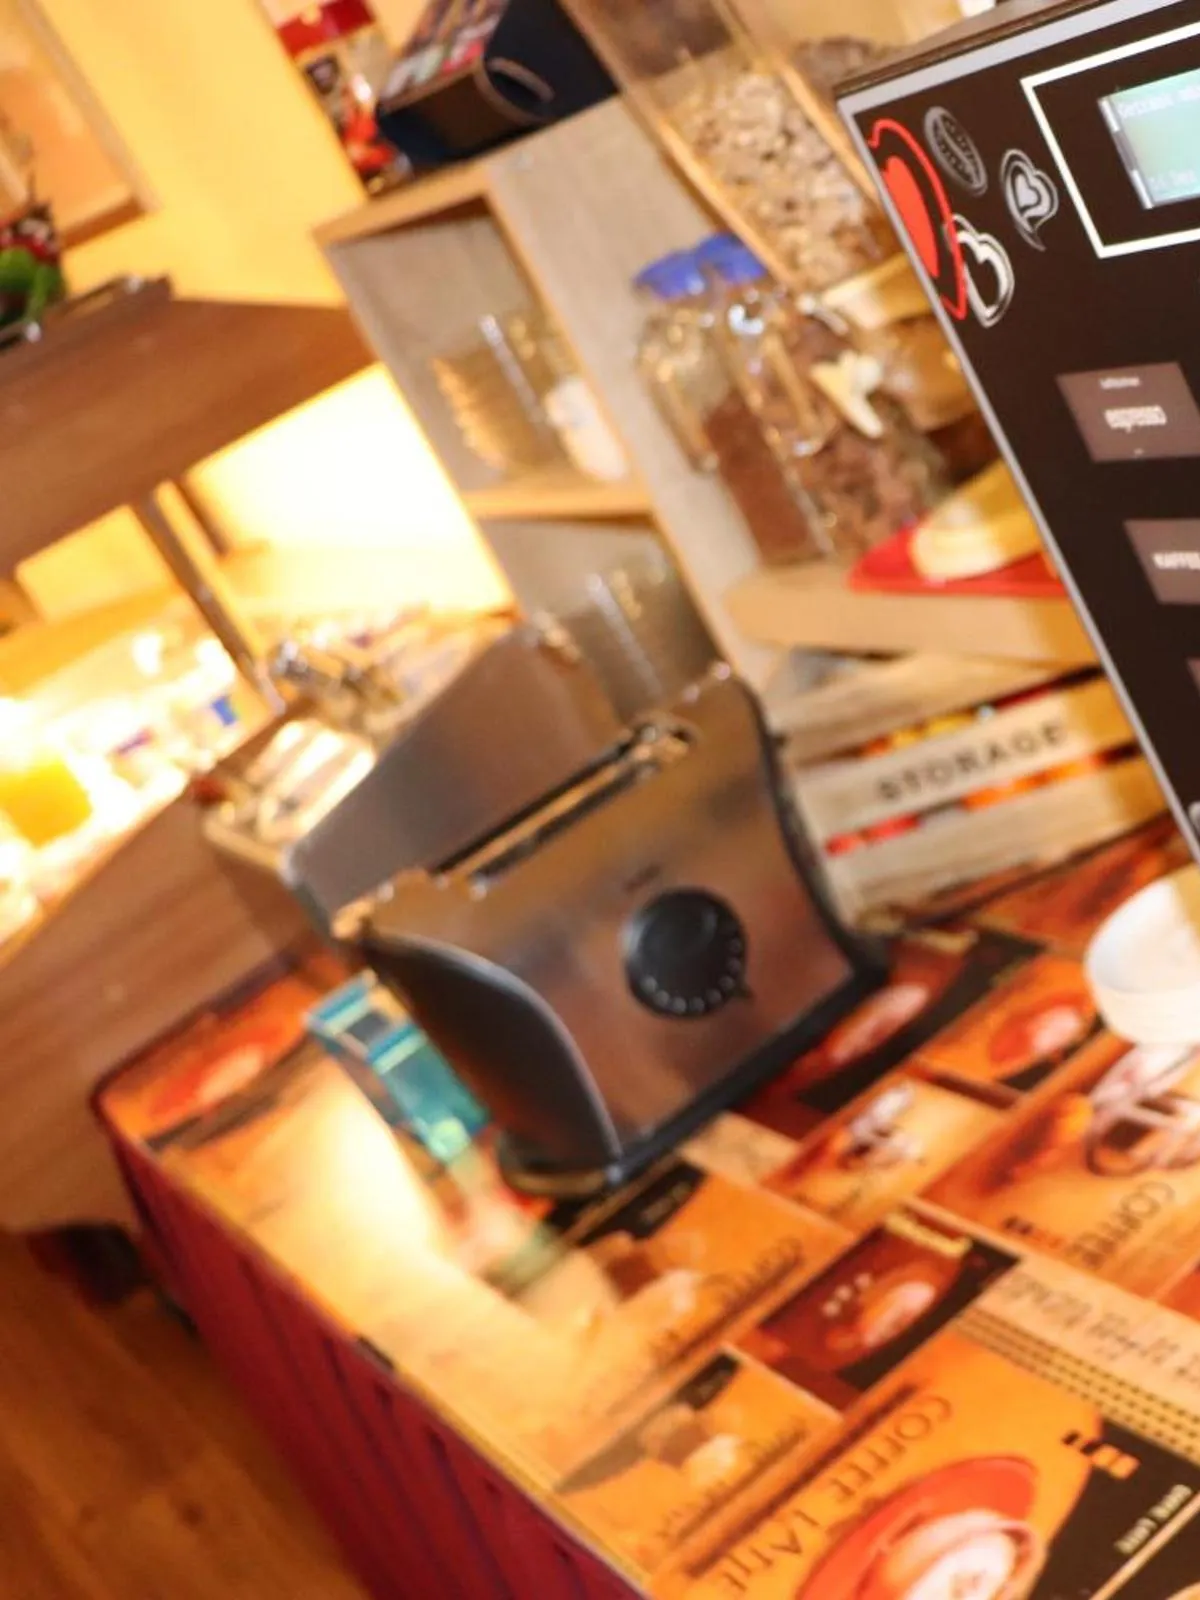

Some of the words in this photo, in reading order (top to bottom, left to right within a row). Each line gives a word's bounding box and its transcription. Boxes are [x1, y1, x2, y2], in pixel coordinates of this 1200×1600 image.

[876, 721, 1064, 800] STORAGE
[1072, 1180, 1176, 1272] COFFEE
[830, 1395, 952, 1502] COFFEE
